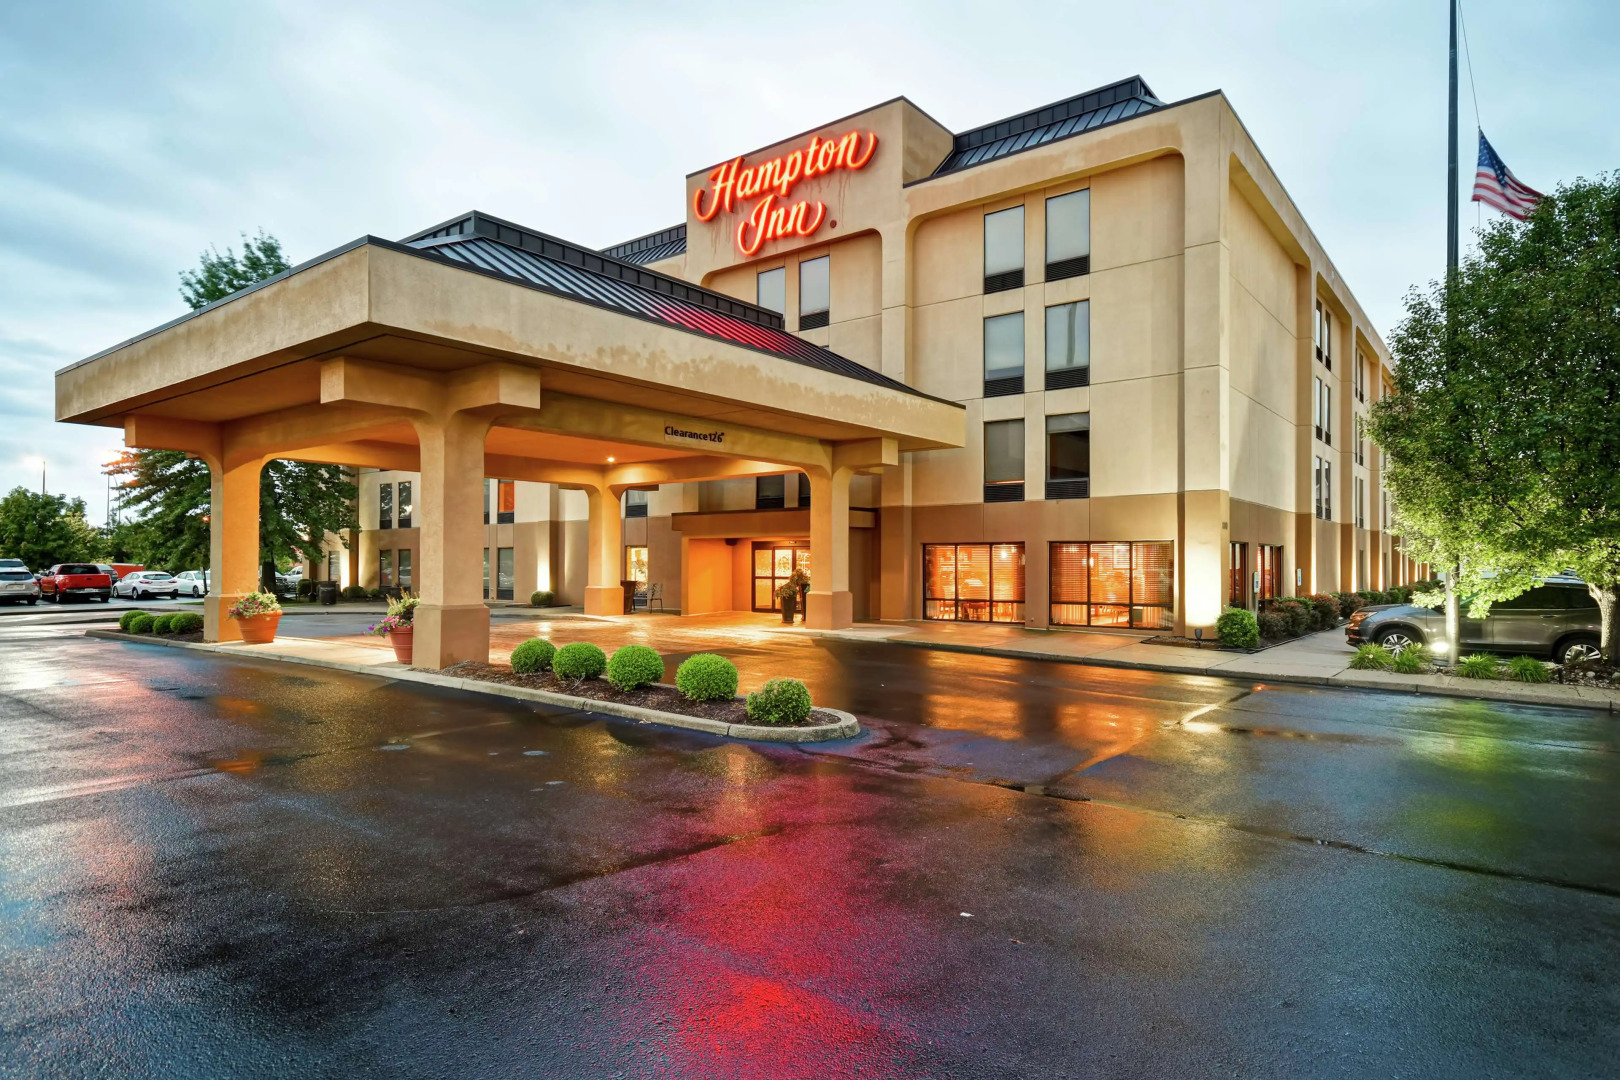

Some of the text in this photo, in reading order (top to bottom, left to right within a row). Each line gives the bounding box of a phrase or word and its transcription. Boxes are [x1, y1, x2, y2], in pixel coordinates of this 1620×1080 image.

[693, 130, 879, 222] Hampton
[737, 194, 827, 256] Inn
[664, 426, 708, 440] Clearance
